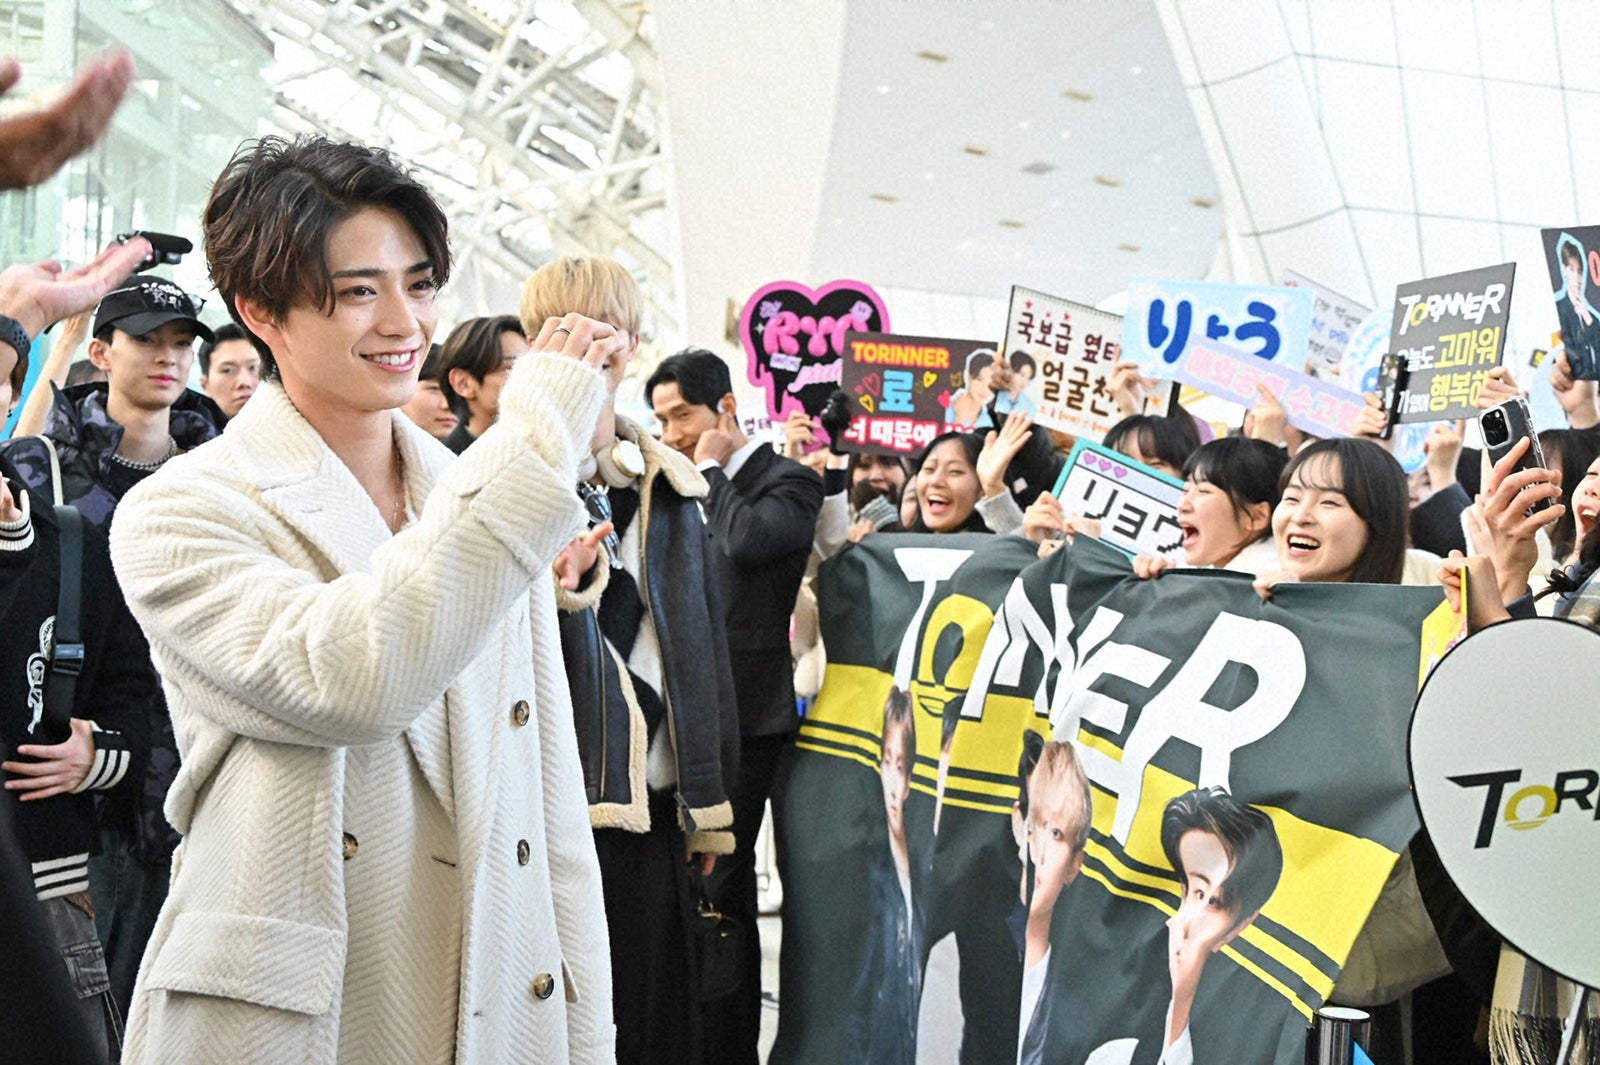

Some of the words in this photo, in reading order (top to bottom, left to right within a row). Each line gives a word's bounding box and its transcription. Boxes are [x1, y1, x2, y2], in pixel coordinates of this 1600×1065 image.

[1399, 283, 1506, 335] TORINNER
[850, 341, 950, 369] TORINNER
[1017, 312, 1073, 355] 국보급
[1433, 326, 1501, 368] 고마워
[879, 370, 915, 413] 료
[1042, 361, 1147, 417] 얼굴천
[869, 419, 938, 449] 때문에
[1083, 479, 1184, 553] リョウ
[1444, 769, 1600, 849] TOR
